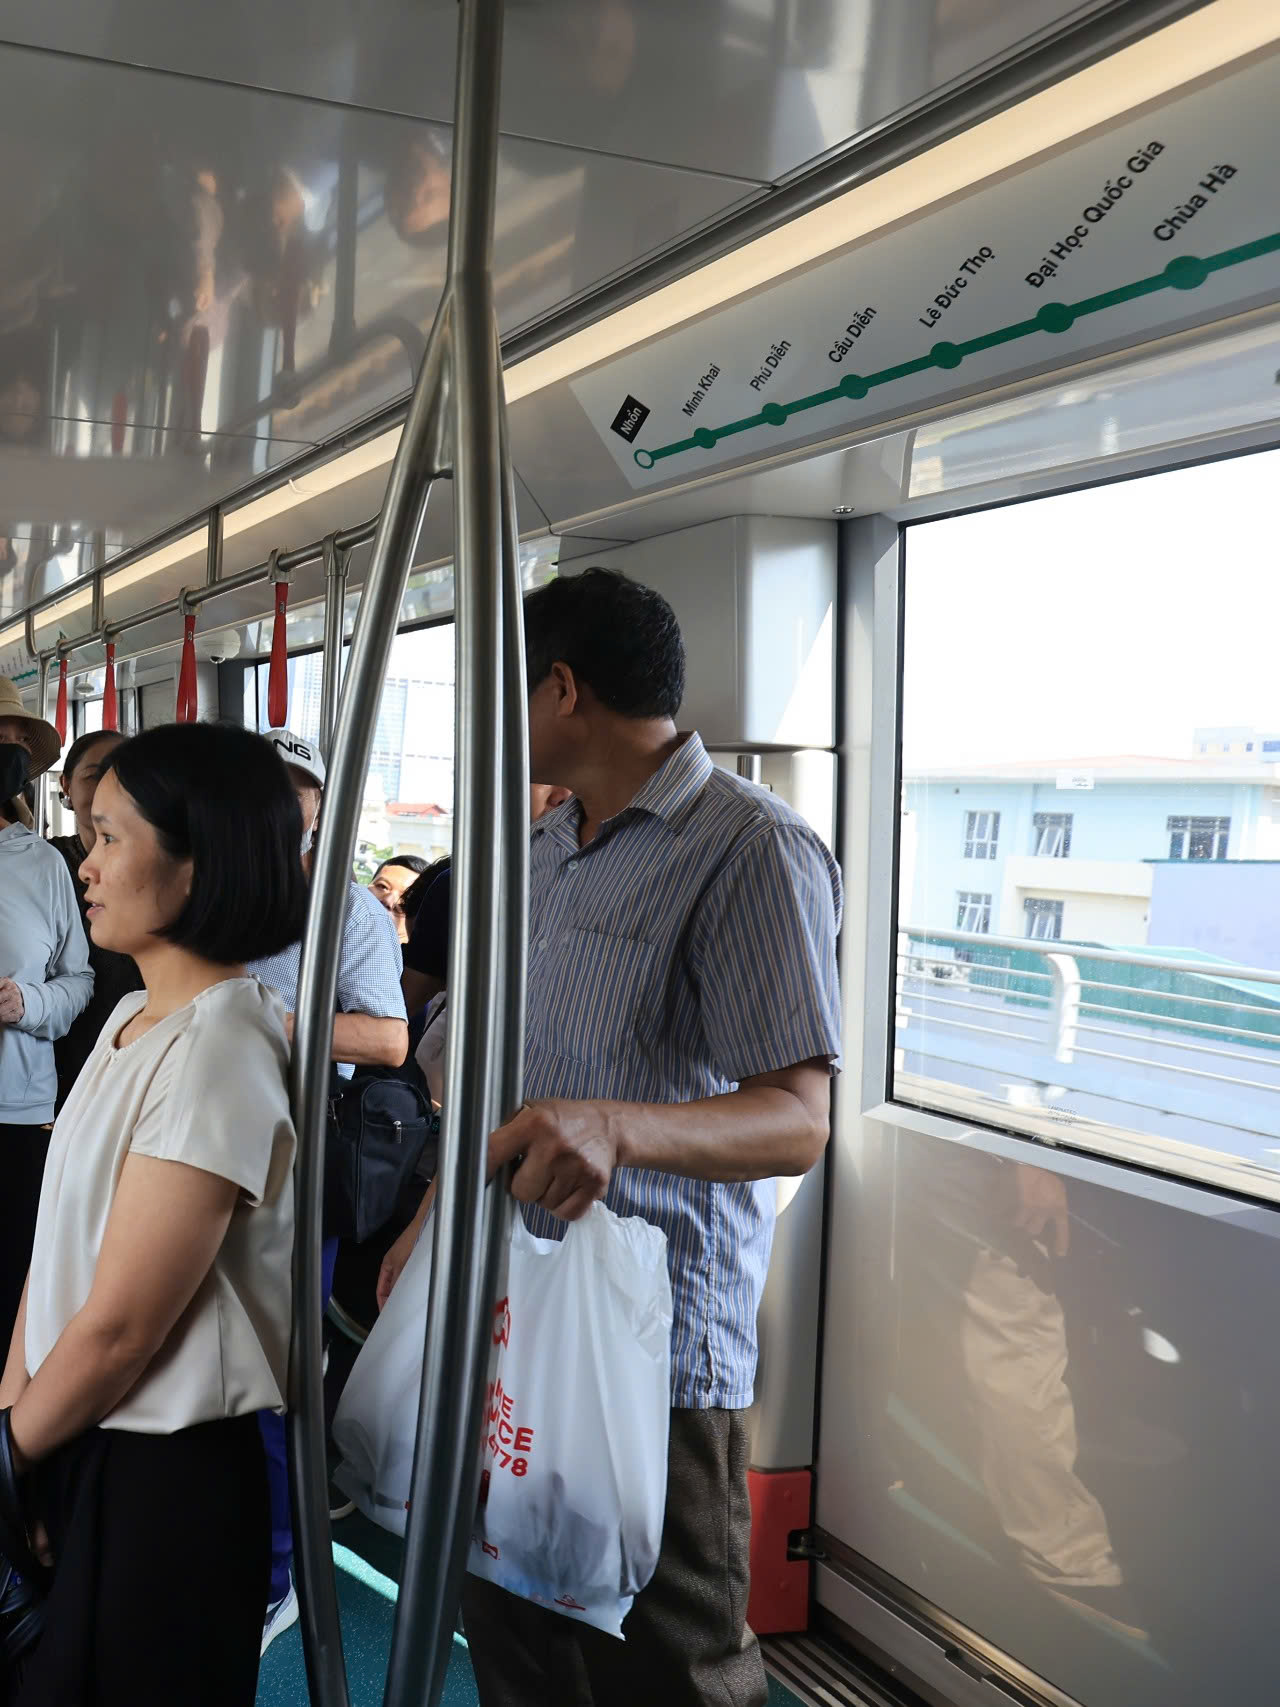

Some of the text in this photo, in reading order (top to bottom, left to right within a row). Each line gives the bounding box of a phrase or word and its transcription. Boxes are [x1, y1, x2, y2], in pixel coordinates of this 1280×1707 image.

[1024, 140, 1166, 288] Đại Học Quốc Gia
[1153, 163, 1238, 242] Chùa Hà
[919, 246, 996, 329] Lê Đức Thọ
[828, 306, 878, 363] Cầu Diễn
[681, 363, 721, 417] Minh Khai
[749, 338, 793, 392] Phú Diễn
[620, 407, 643, 435] Nhổn
